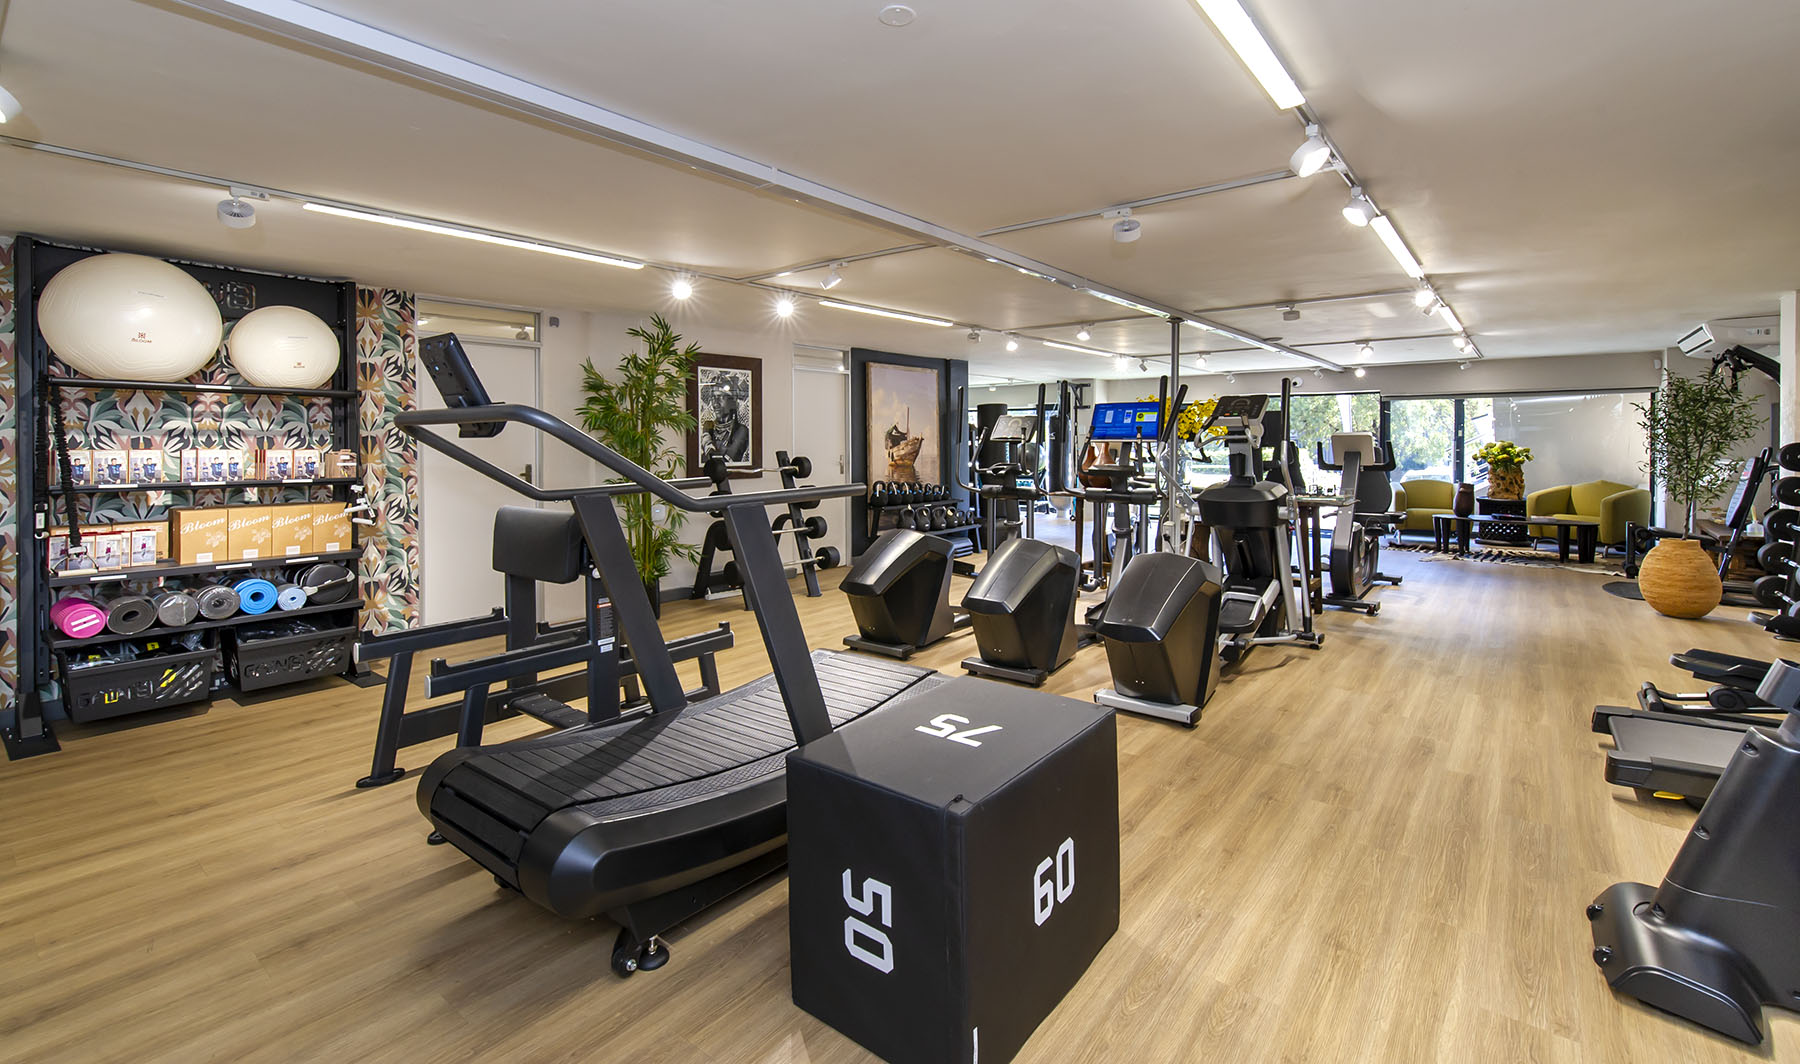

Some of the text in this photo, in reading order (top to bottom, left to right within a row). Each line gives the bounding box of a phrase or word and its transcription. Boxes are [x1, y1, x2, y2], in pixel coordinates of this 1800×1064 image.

[181, 517, 226, 534] Bloom
[228, 514, 270, 531] Bloom
[272, 512, 312, 528] Bloom
[313, 510, 349, 526] Bloom
[914, 713, 1003, 748] 75
[1033, 836, 1075, 927] 60
[842, 868, 894, 975] 50
